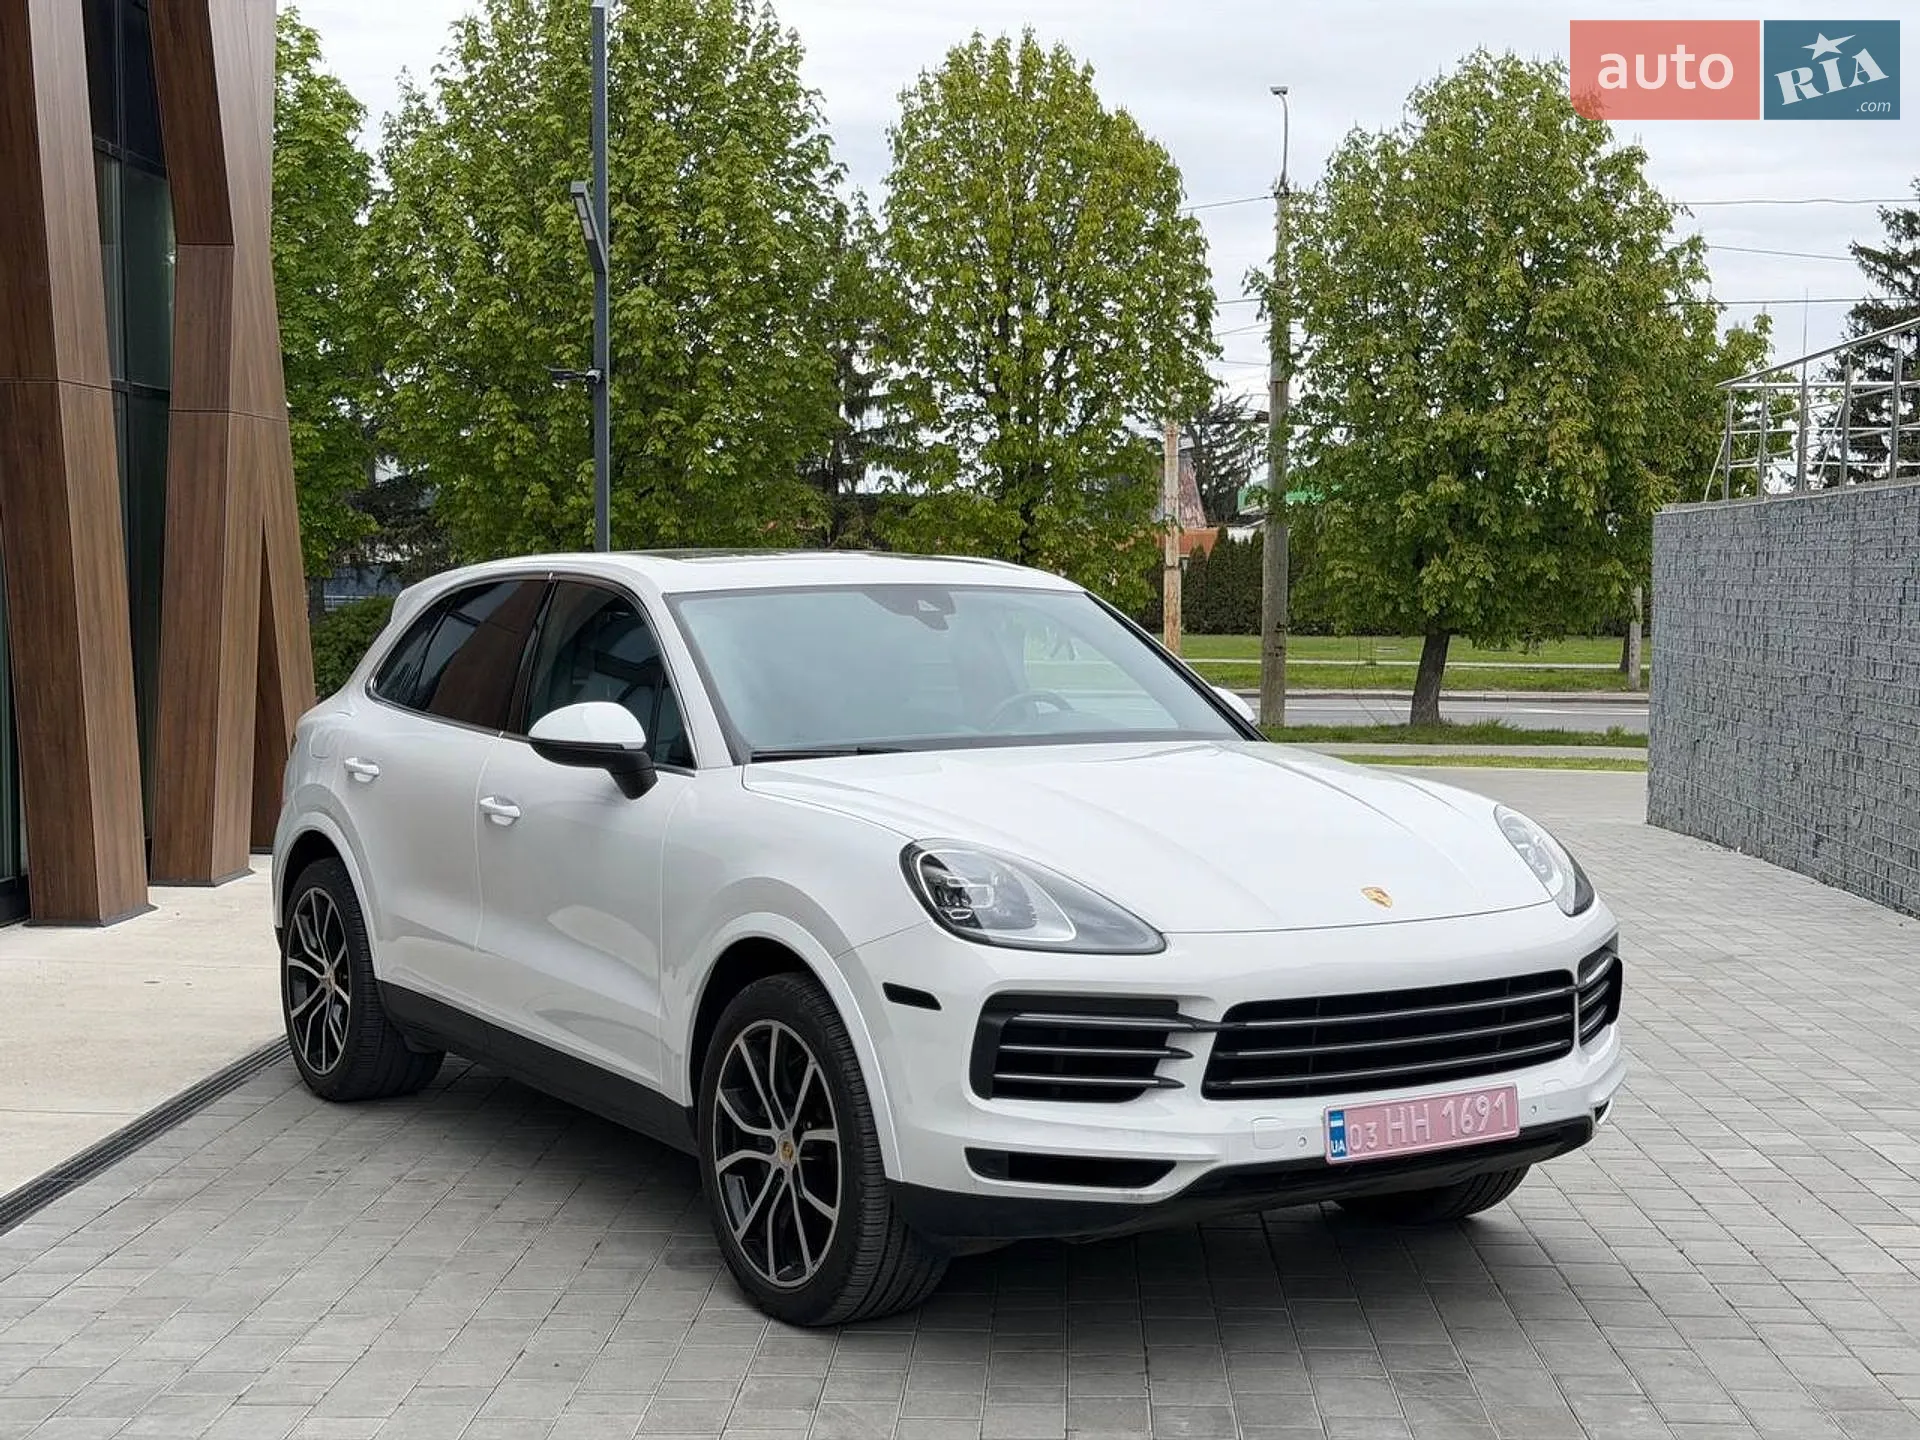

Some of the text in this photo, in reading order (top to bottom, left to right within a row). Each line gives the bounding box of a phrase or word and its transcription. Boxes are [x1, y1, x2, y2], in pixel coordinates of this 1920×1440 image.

[1350, 1091, 1509, 1151] 03 HH 1691
[1331, 1139, 1346, 1153] UA
